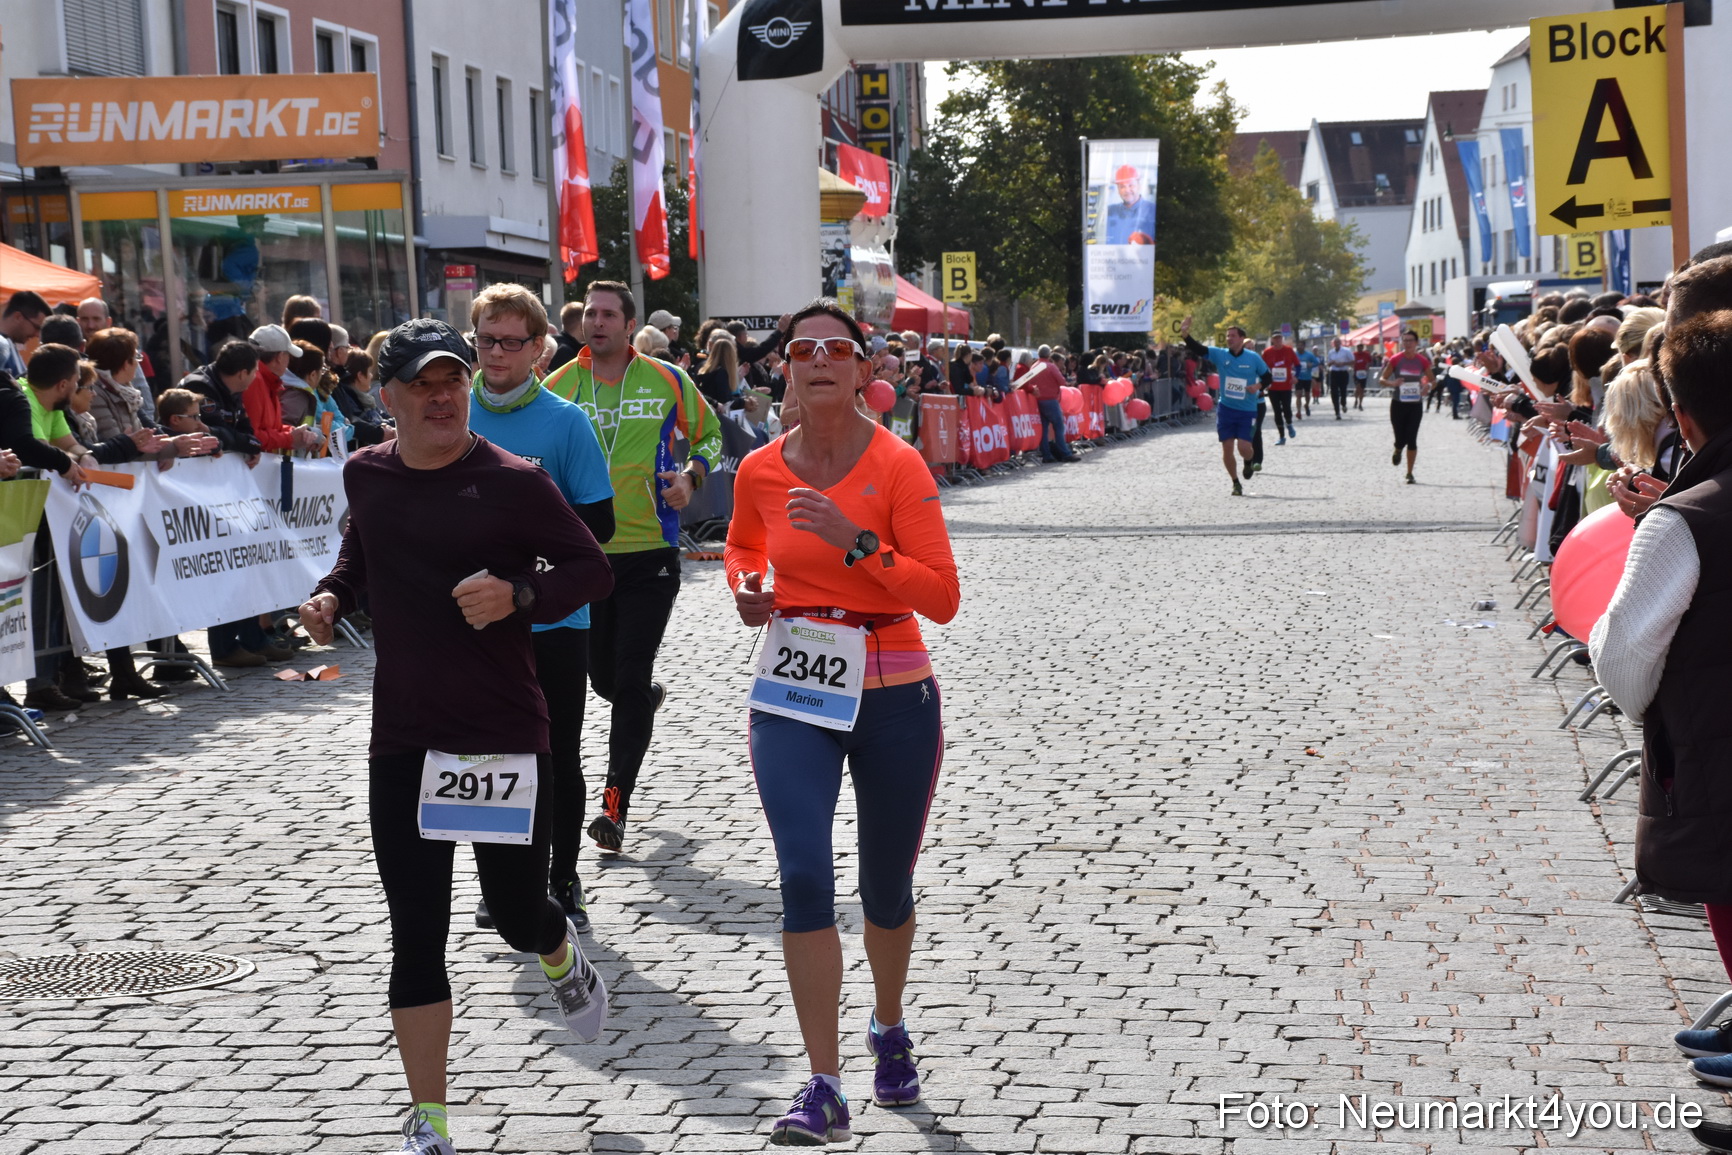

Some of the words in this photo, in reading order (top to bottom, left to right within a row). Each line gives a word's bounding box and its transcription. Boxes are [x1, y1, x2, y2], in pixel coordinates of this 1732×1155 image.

[768, 28, 790, 37] MINI
[1549, 16, 1666, 63] Block
[28, 98, 361, 144] RUNMARKT.DE
[1566, 77, 1654, 186] A
[184, 193, 309, 212] RUNMARKT.DE
[946, 254, 971, 263] Block
[1577, 241, 1596, 266] B
[951, 267, 968, 291] B
[1090, 303, 1130, 315] swn
[1481, 377, 1499, 387] swn
[161, 505, 210, 546] BMW
[172, 553, 226, 581] WENIGER
[224, 541, 279, 570] VERBRAUCH.
[801, 628, 836, 642] BOCK
[772, 646, 848, 689] 2342
[786, 691, 824, 708] Marion
[435, 771, 520, 801] 2917
